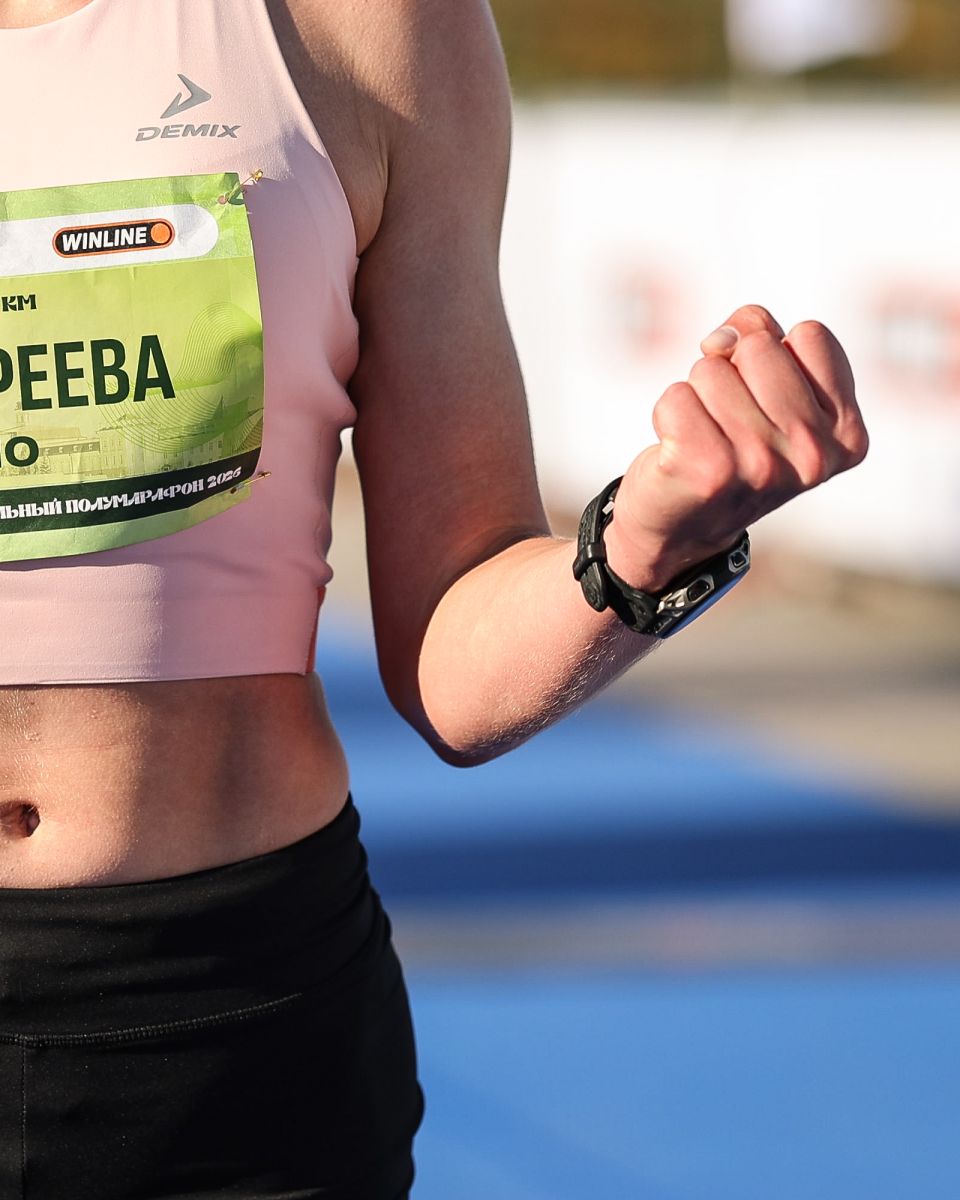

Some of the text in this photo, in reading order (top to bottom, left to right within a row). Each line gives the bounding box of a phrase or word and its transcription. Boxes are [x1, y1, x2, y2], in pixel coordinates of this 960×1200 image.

[135, 123, 242, 142] DEMIX
[61, 226, 148, 252] WINLINE
[65, 478, 205, 513] ПОЛУМАРАФОН
